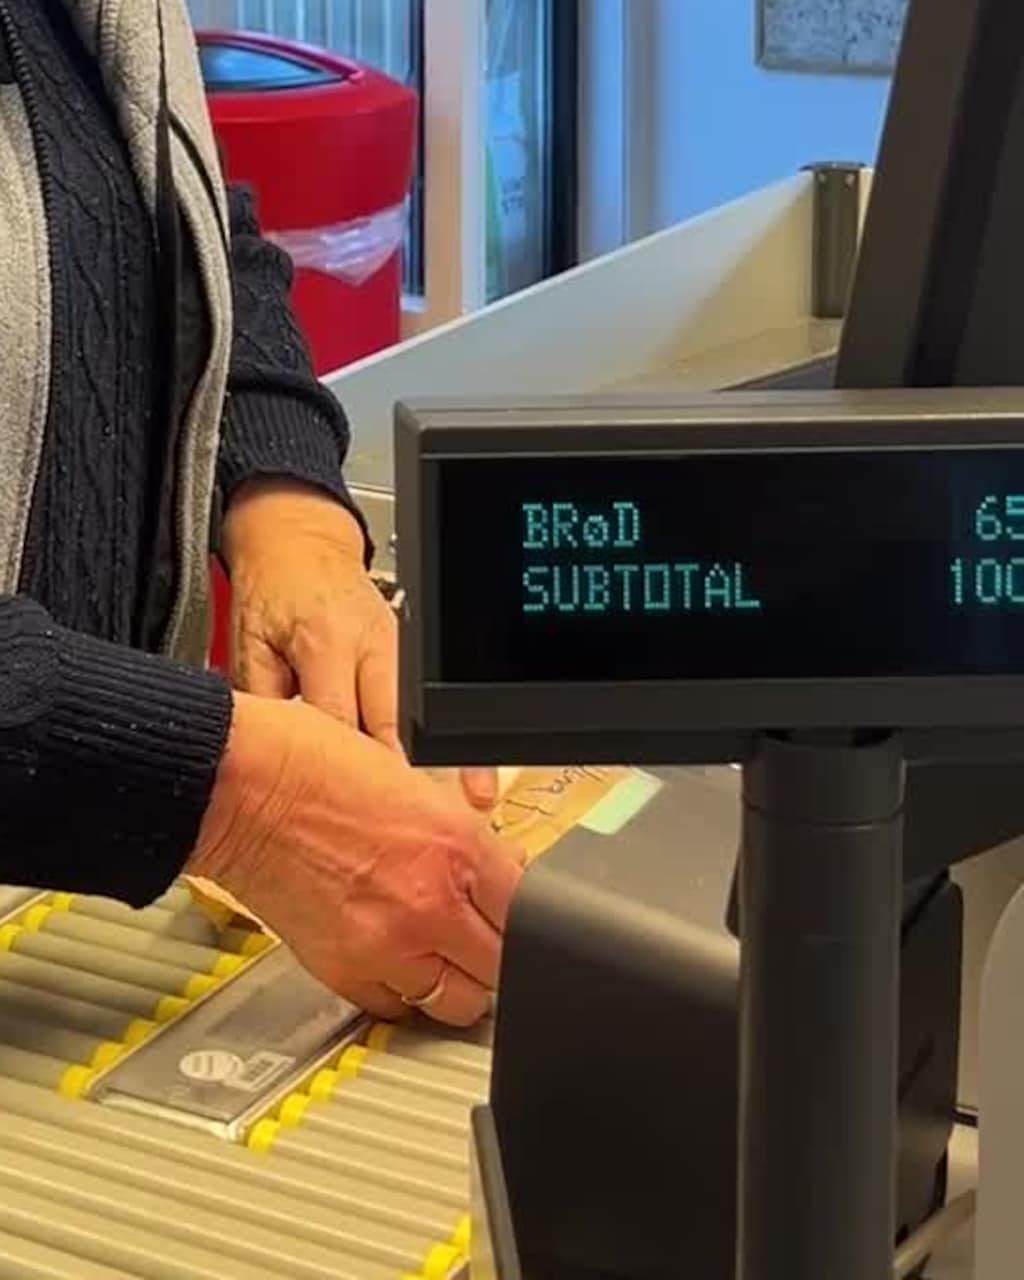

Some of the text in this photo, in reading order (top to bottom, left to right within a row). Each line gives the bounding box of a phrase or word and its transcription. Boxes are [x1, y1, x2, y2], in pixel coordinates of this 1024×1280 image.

[975, 495, 1024, 540] 65
[522, 557, 1024, 612] SUBTOTAL 100
